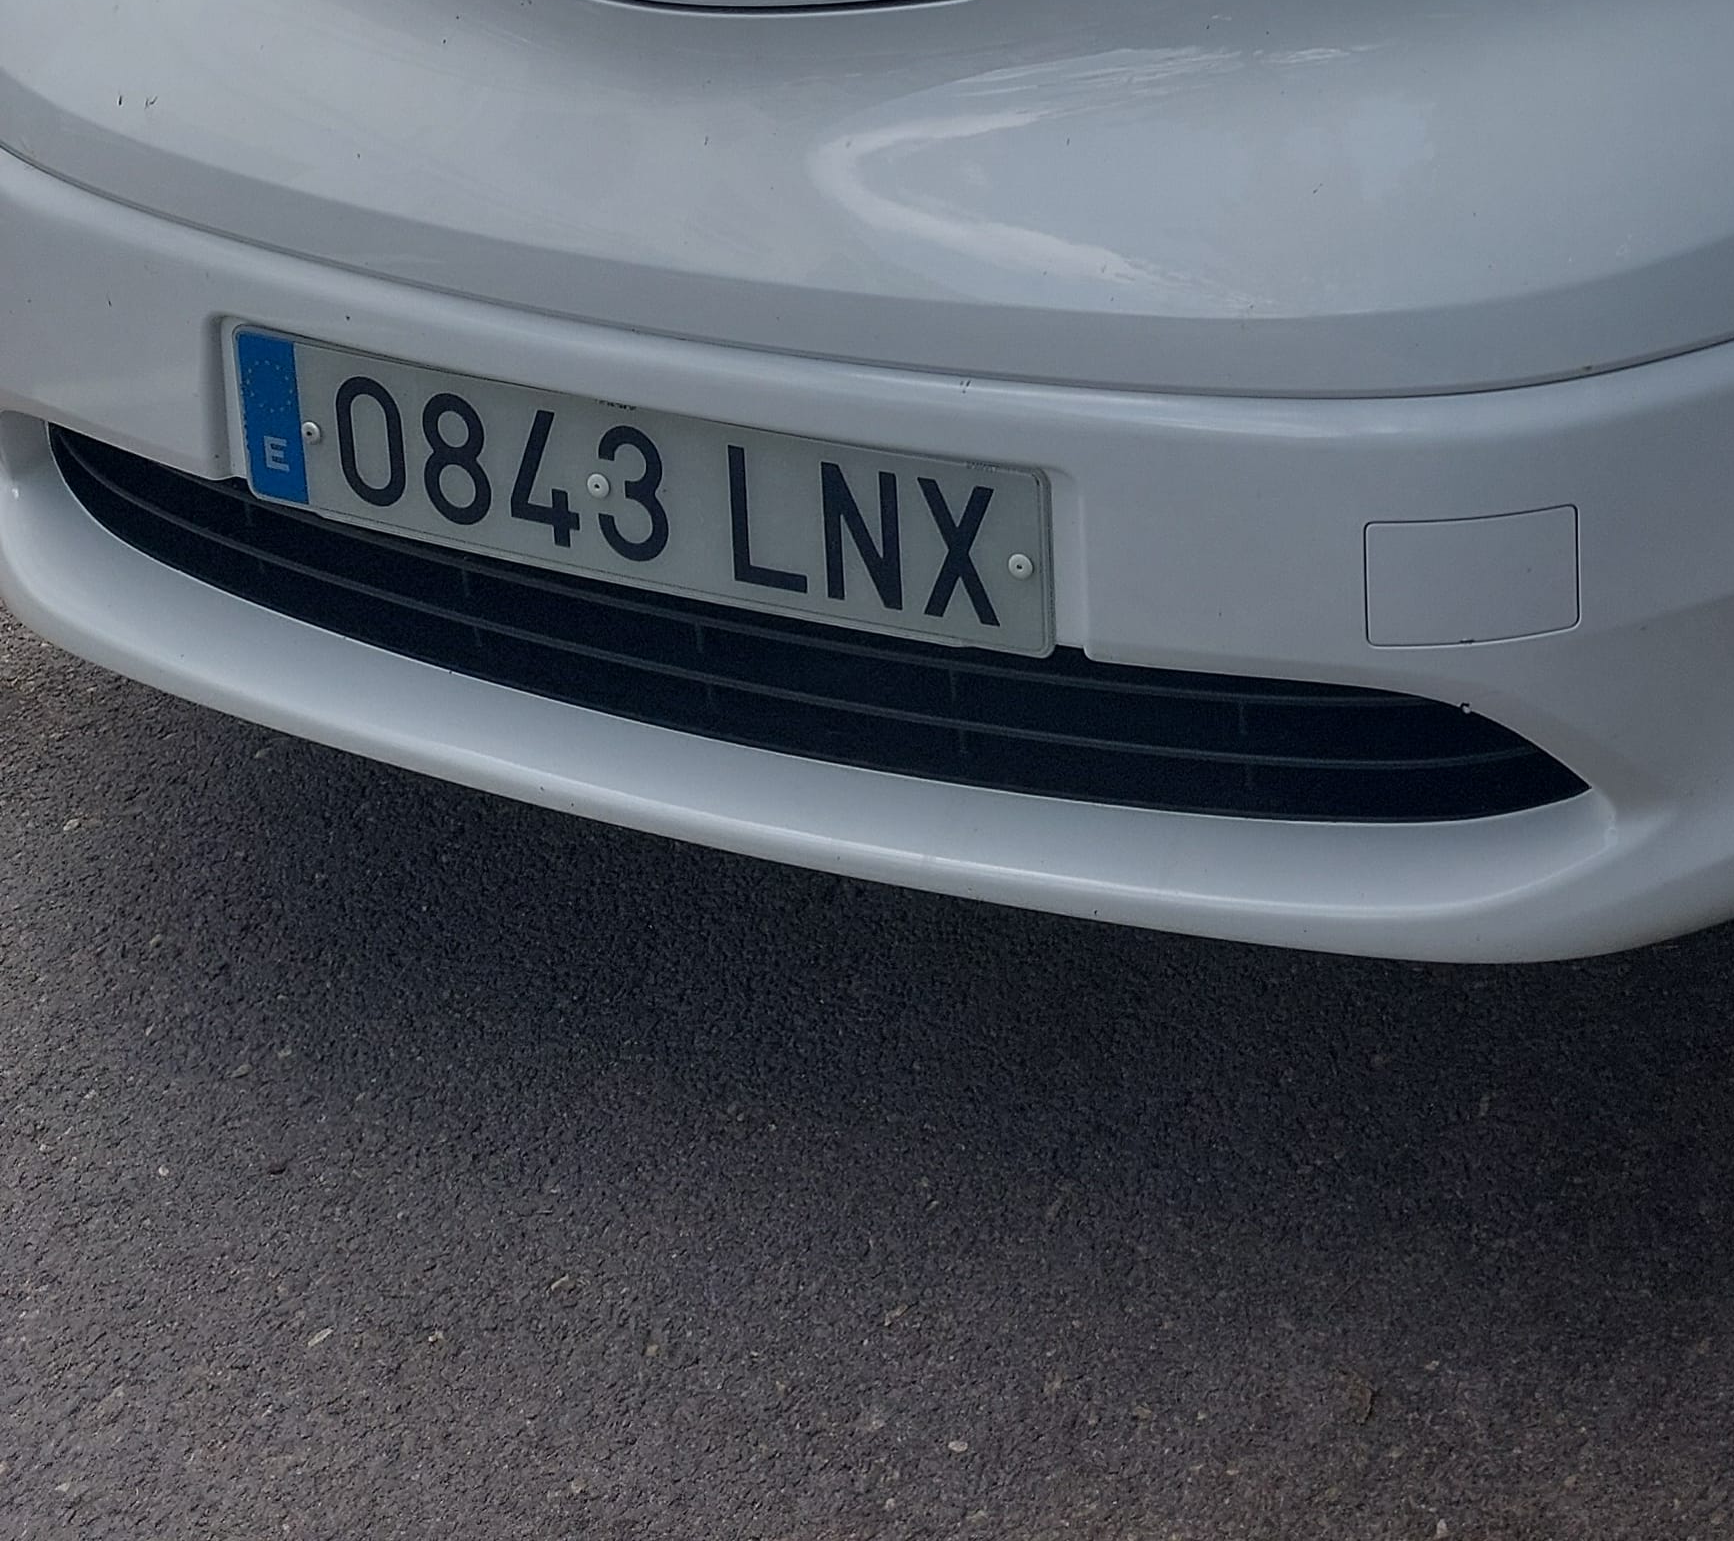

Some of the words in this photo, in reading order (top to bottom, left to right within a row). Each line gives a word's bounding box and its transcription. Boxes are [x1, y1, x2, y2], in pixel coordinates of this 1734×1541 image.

[263, 435, 290, 473] E
[335, 375, 669, 563] 0843
[727, 444, 1000, 628] LNX
